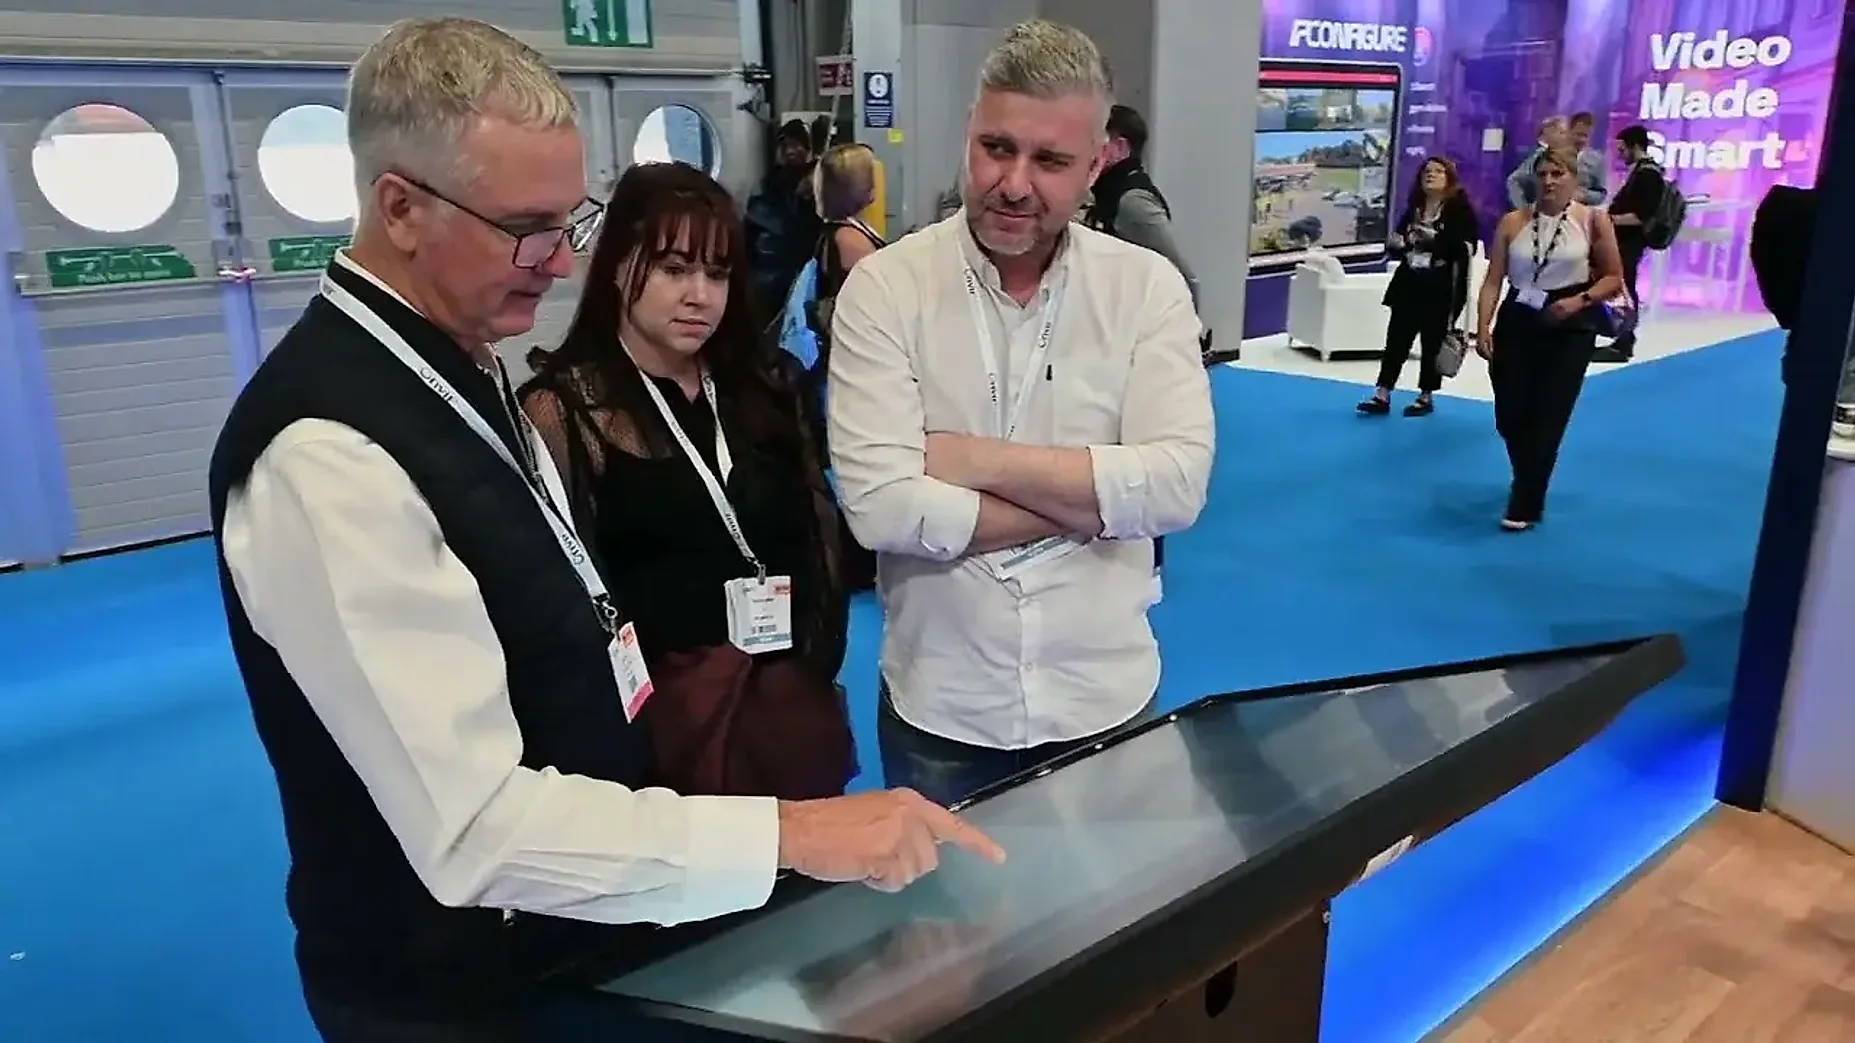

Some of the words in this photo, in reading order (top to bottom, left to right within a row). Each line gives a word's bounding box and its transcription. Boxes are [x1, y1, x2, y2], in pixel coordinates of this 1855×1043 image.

[1651, 29, 1792, 70] Video
[1639, 79, 1778, 120] Made
[1646, 131, 1786, 170] Smart
